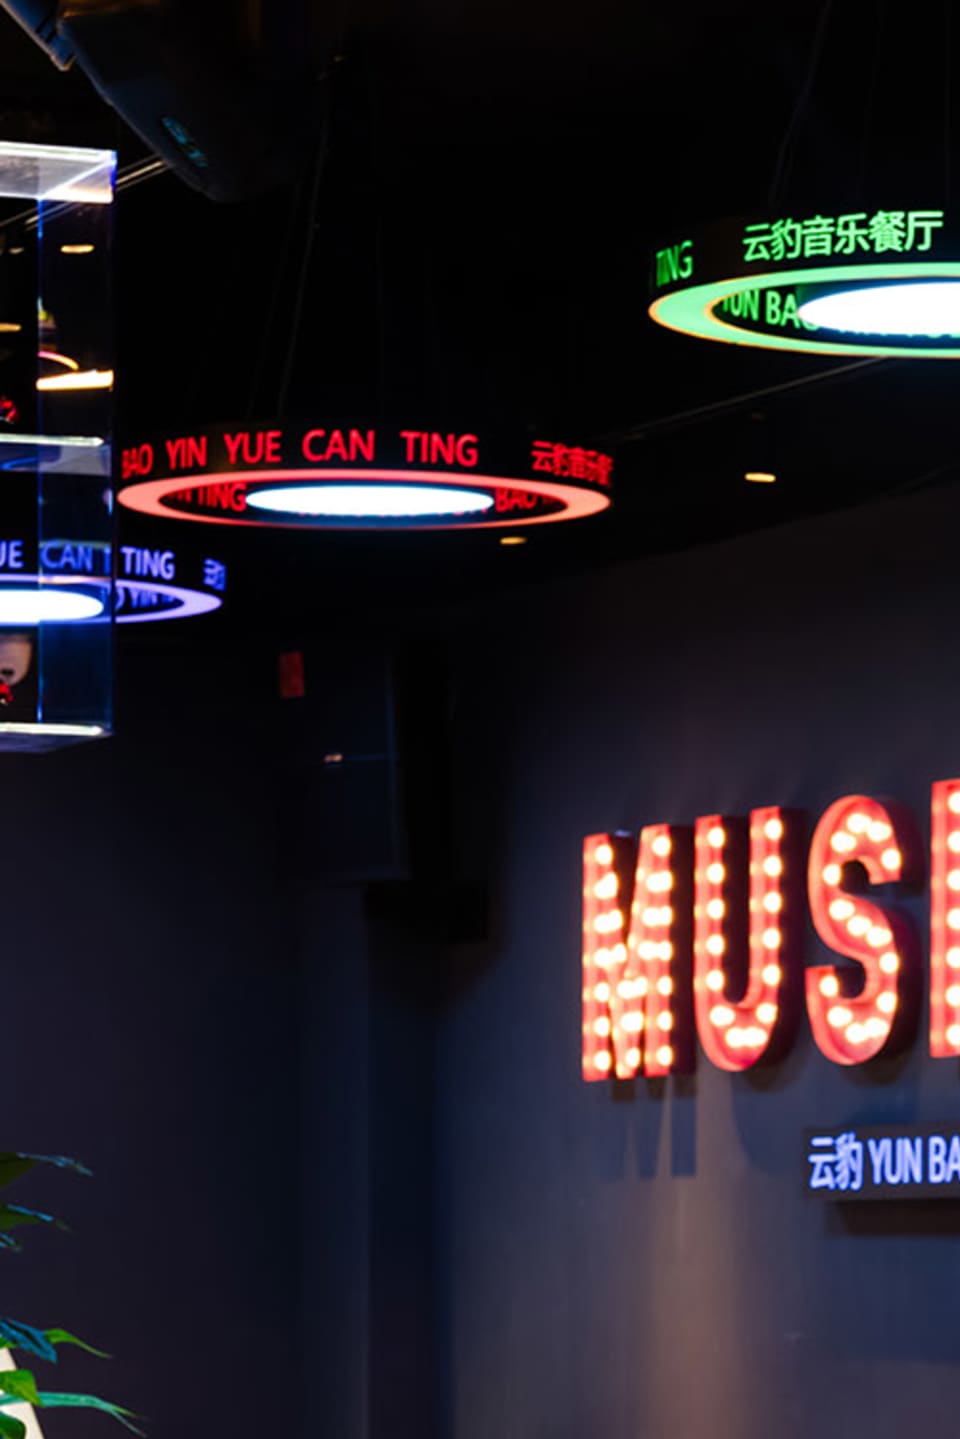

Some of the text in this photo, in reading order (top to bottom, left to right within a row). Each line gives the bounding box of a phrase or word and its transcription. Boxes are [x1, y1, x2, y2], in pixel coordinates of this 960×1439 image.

[742, 210, 944, 262] 云豹音乐餐厅
[121, 443, 154, 480] BAO
[165, 436, 208, 471] YIN
[223, 430, 282, 464] YUE
[302, 428, 376, 463] CAN
[400, 429, 479, 468] TING
[41, 539, 93, 572] CAN
[119, 546, 175, 581] TING
[808, 1131, 863, 1191] 云豹
[867, 1137, 923, 1185] YUN
